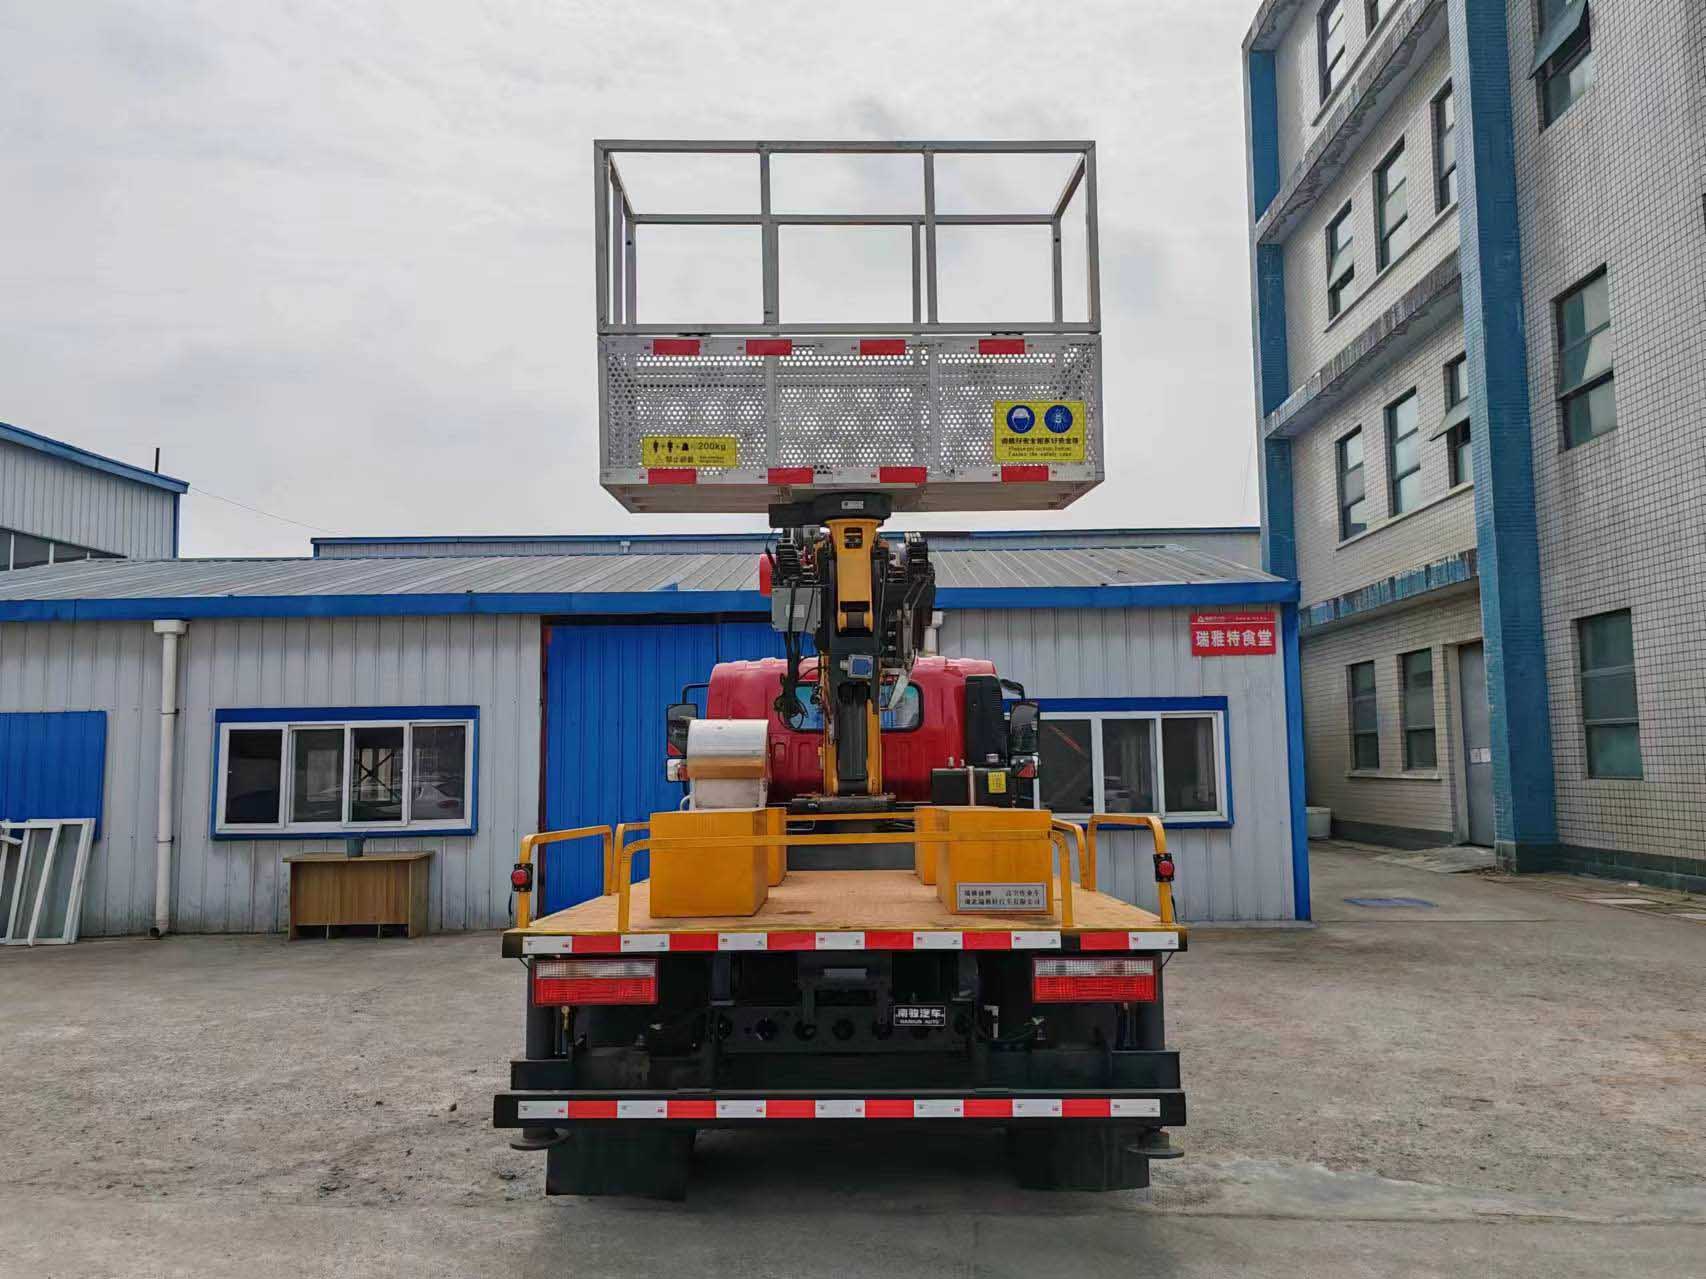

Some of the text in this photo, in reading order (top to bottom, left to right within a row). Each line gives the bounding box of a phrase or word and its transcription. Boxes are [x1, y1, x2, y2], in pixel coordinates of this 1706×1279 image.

[697, 442, 726, 451] 200kg
[1195, 629, 1273, 648] 瑞雅特食堂
